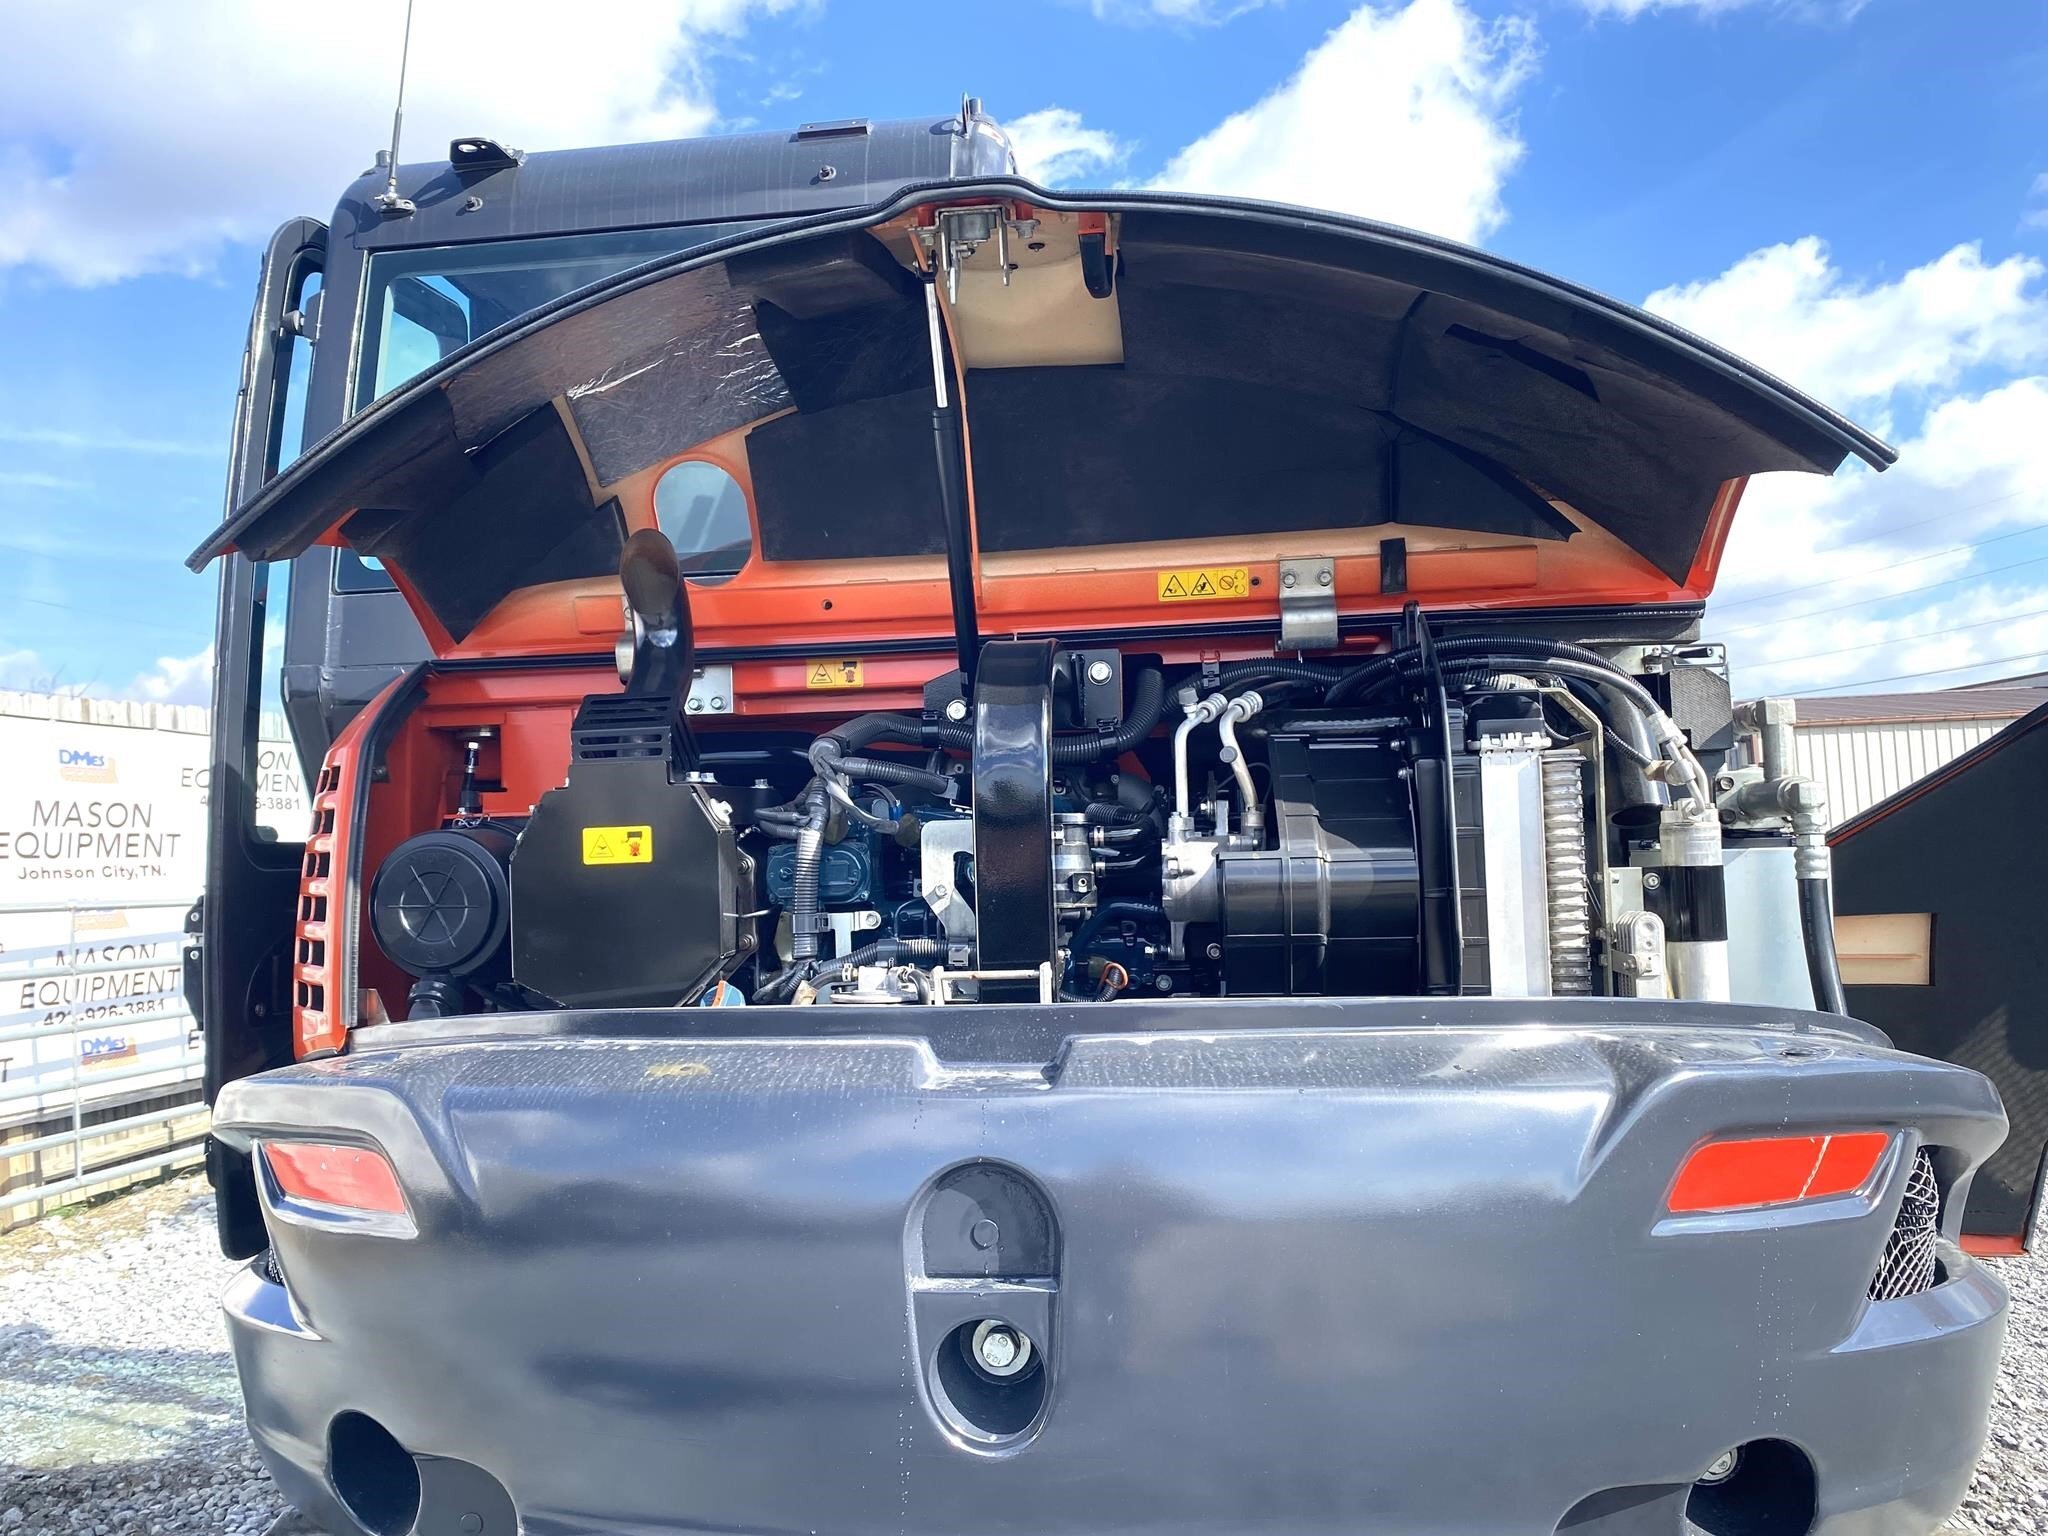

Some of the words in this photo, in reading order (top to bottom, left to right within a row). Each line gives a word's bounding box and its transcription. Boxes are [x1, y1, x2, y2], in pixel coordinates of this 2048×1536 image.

[33, 800, 152, 828] MASON
[0, 831, 181, 859] EQUIPMENT
[18, 866, 95, 880] Johnson
[20, 967, 181, 1009] EQUIPMENT
